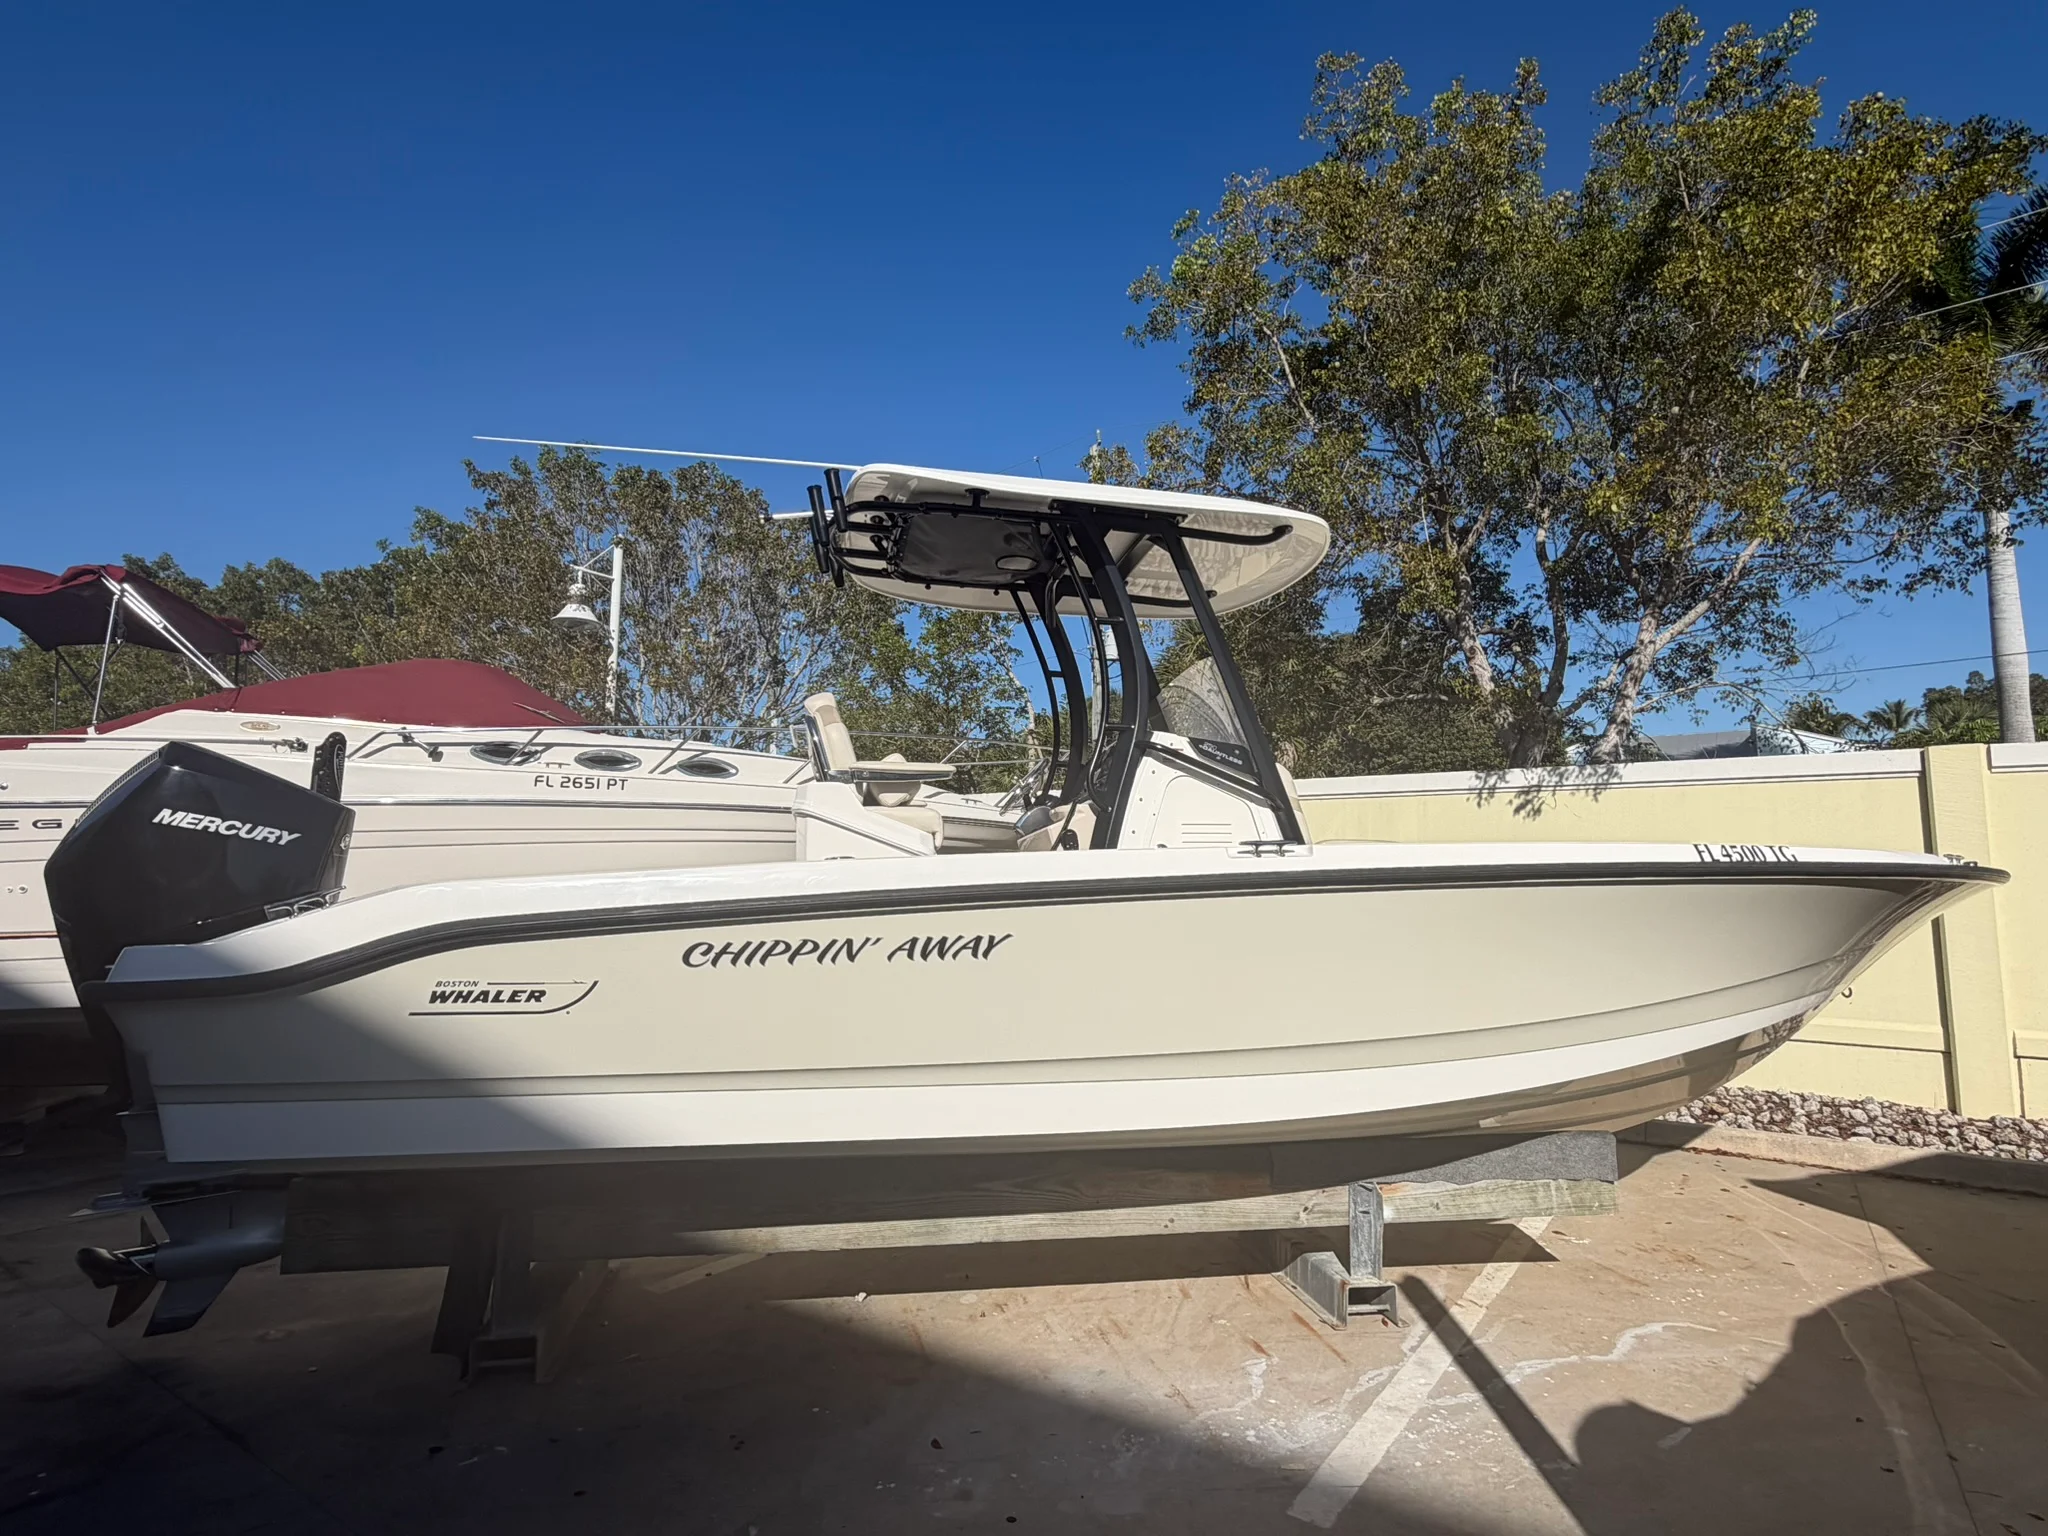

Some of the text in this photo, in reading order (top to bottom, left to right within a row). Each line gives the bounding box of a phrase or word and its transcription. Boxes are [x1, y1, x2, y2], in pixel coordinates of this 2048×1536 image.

[534, 775, 629, 791] FL 2651 PT
[152, 808, 302, 846] MERCURY
[1721, 844, 1767, 862] 4500
[682, 933, 1014, 968] CHIPPIN' AWAY
[435, 980, 480, 988] BOSTON
[428, 989, 548, 1004] WHALER
